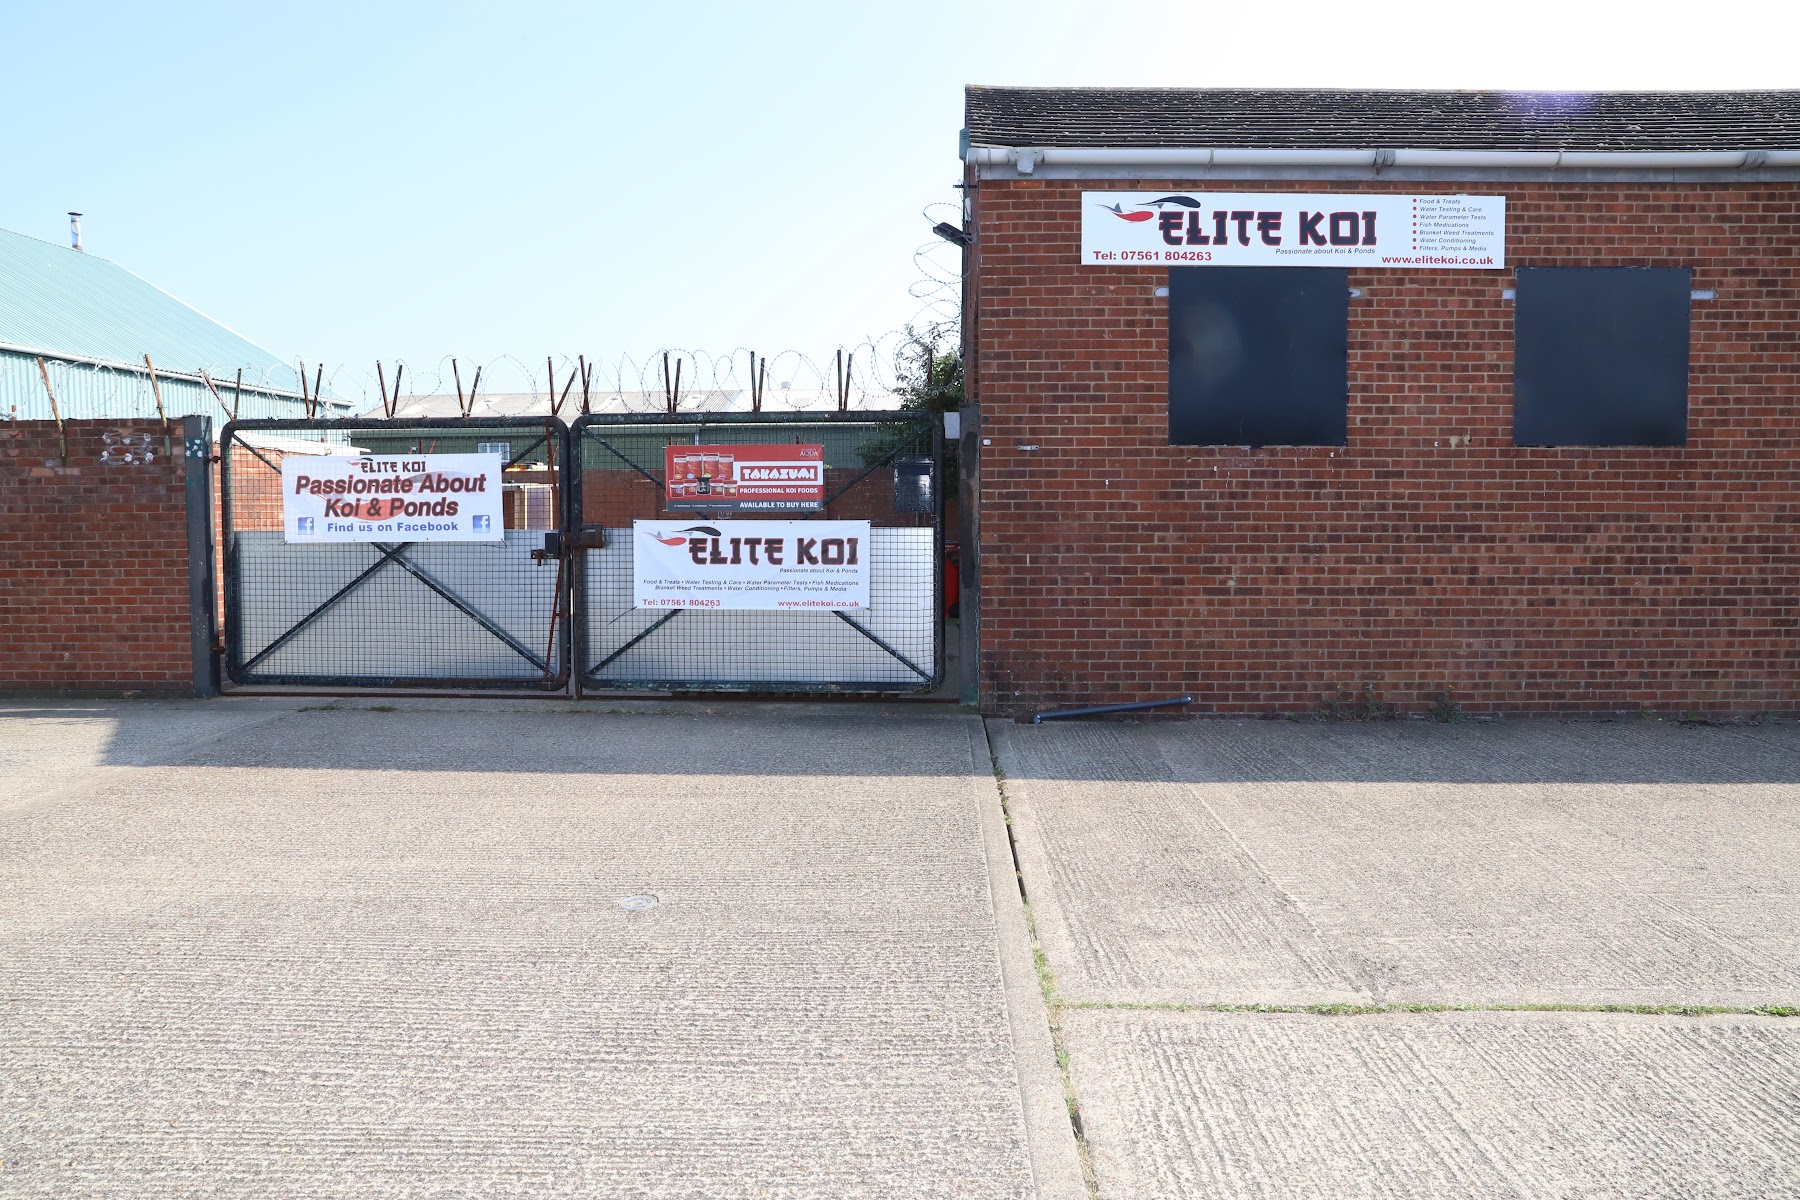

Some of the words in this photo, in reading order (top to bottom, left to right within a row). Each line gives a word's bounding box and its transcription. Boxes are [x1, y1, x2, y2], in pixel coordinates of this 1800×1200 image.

[1159, 211, 1282, 246] ELITE
[1299, 211, 1377, 246] KOI
[1093, 251, 1116, 260] Tel:
[1121, 251, 1159, 261] 07561
[1165, 252, 1212, 261] 804263
[1382, 256, 1493, 265] www.elitekoi.co.uk
[361, 461, 398, 473] ELITE
[402, 461, 426, 472] KOI
[743, 468, 815, 480] TAKAZUMI
[295, 474, 413, 495] Passionate
[418, 473, 487, 493] About
[324, 499, 361, 518] Koi
[366, 497, 382, 517] &
[389, 497, 459, 517] Ponds
[327, 522, 354, 532] Find
[358, 524, 373, 532] us
[377, 523, 392, 532] on
[397, 522, 458, 531] Facebook
[689, 537, 784, 566] ELITE
[797, 537, 858, 565] KOI
